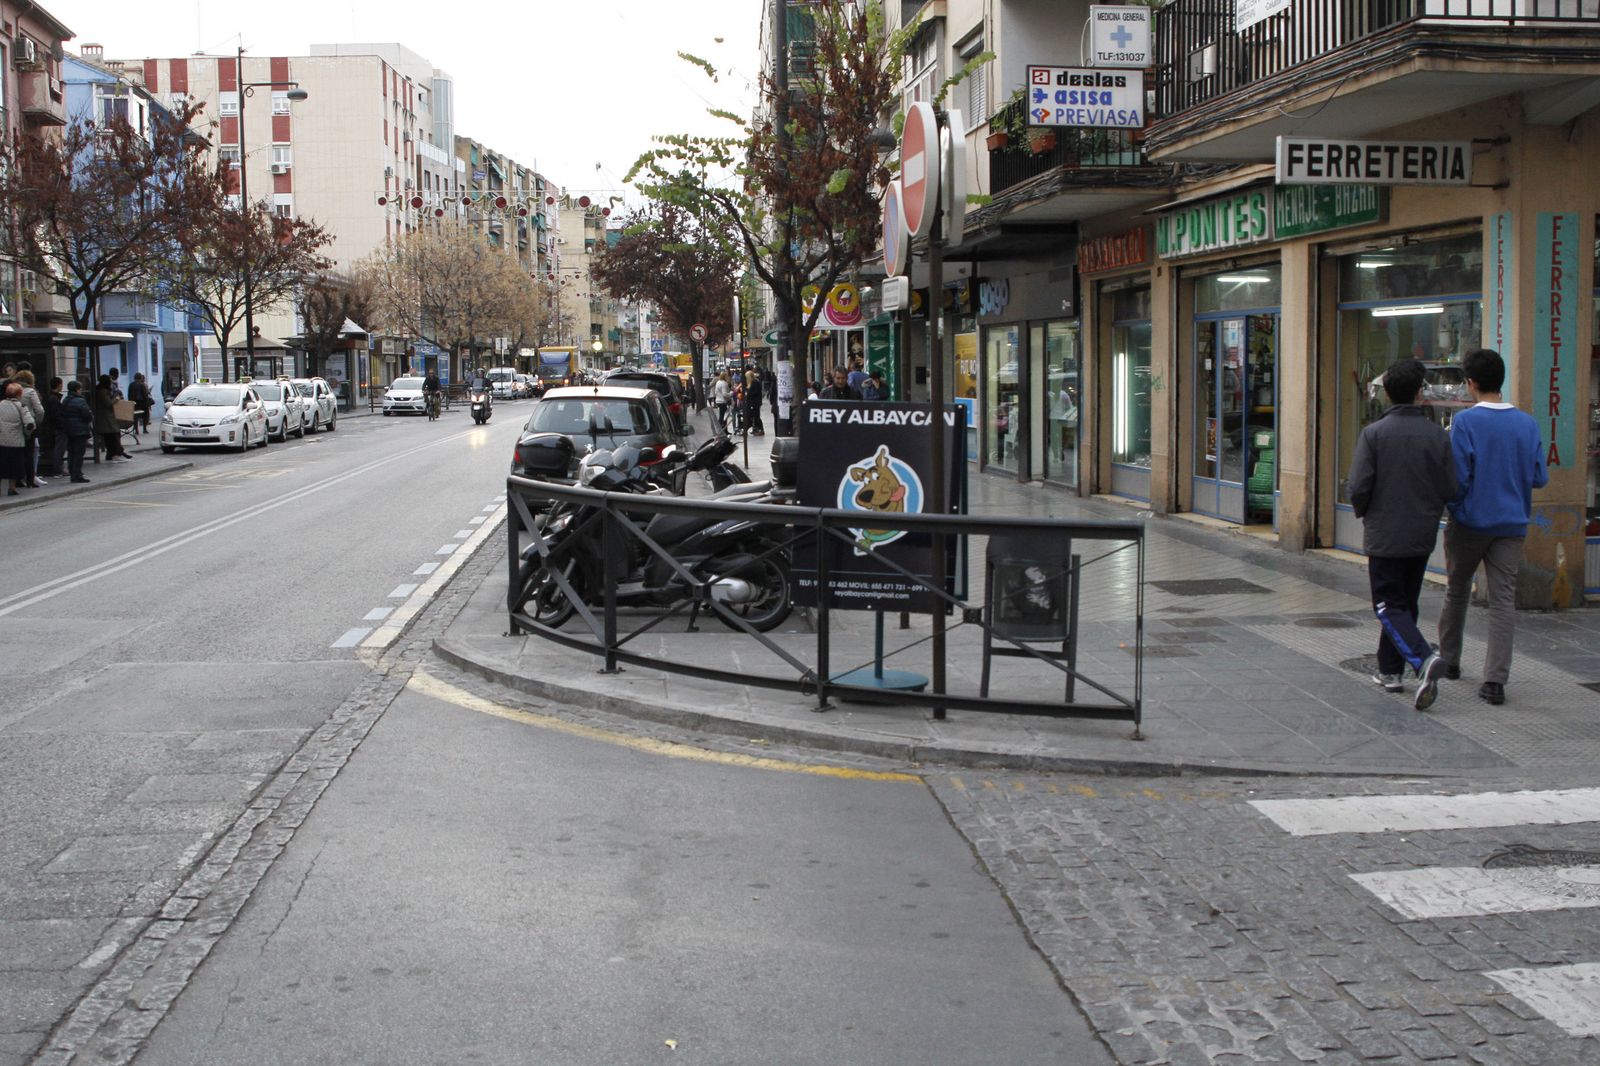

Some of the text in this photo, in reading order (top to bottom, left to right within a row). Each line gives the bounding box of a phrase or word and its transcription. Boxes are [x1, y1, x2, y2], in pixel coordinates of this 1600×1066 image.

[1097, 12, 1146, 22] MEDICINA GENERAL
[1056, 71, 1127, 88] deslas
[1054, 89, 1113, 105] asisa
[1055, 108, 1140, 126] PREVIASA
[1287, 143, 1465, 180] FERRETERIA
[1276, 185, 1319, 229] MENAJE
[1546, 215, 1564, 467] FERRETERIA
[809, 408, 847, 423] REY
